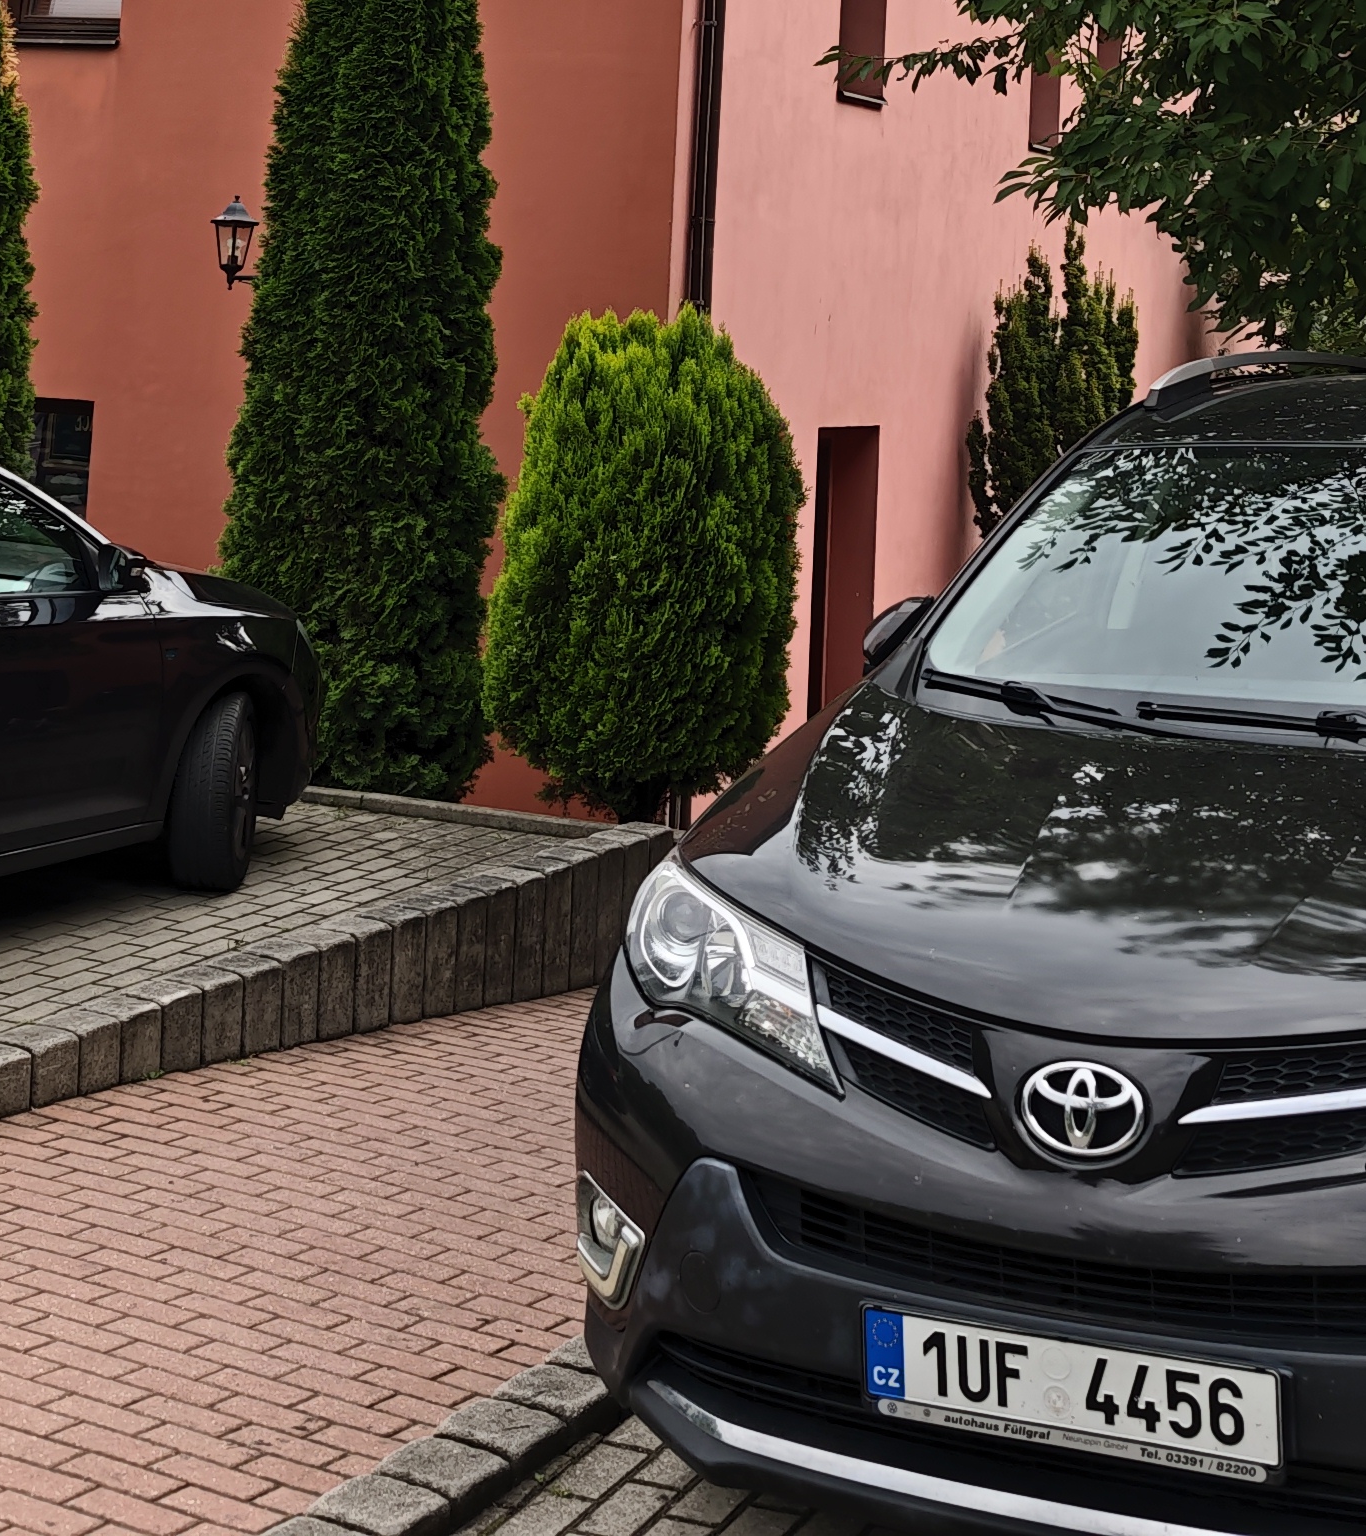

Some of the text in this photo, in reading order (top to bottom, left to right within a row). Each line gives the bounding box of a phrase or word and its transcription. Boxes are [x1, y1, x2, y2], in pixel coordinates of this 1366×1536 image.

[872, 1365, 901, 1388] CZ
[922, 1330, 1246, 1447] 1UF 4456
[943, 1414, 1000, 1432] autohaus
[1003, 1423, 1051, 1441] Füllgraf
[1140, 1446, 1162, 1461] Tel.
[1165, 1451, 1204, 1468] 03391
[1215, 1460, 1258, 1478] 82200
